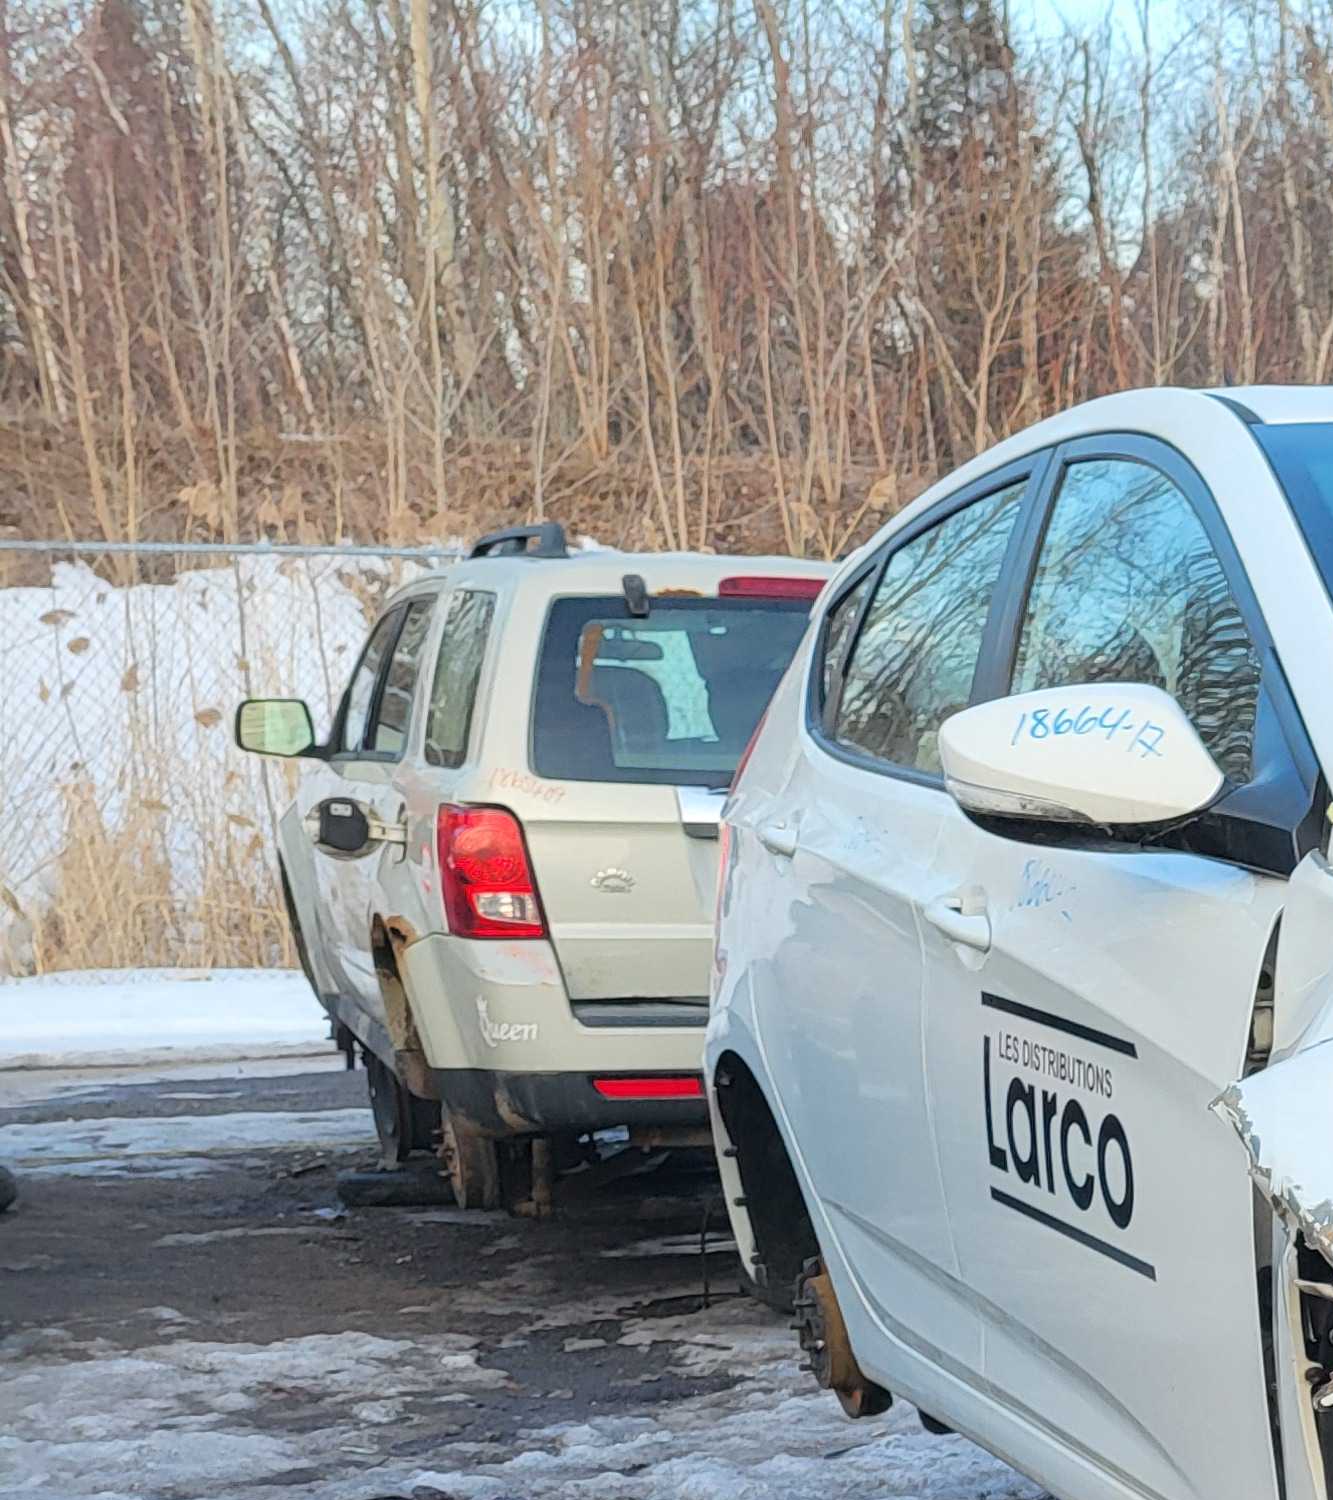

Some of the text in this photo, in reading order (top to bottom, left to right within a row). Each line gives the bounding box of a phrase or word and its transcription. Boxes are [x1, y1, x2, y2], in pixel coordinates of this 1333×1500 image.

[478, 1010, 538, 1048] Queen
[998, 1030, 1113, 1099] LES DISTRIBUTIONS
[984, 1035, 1134, 1230] Larco
